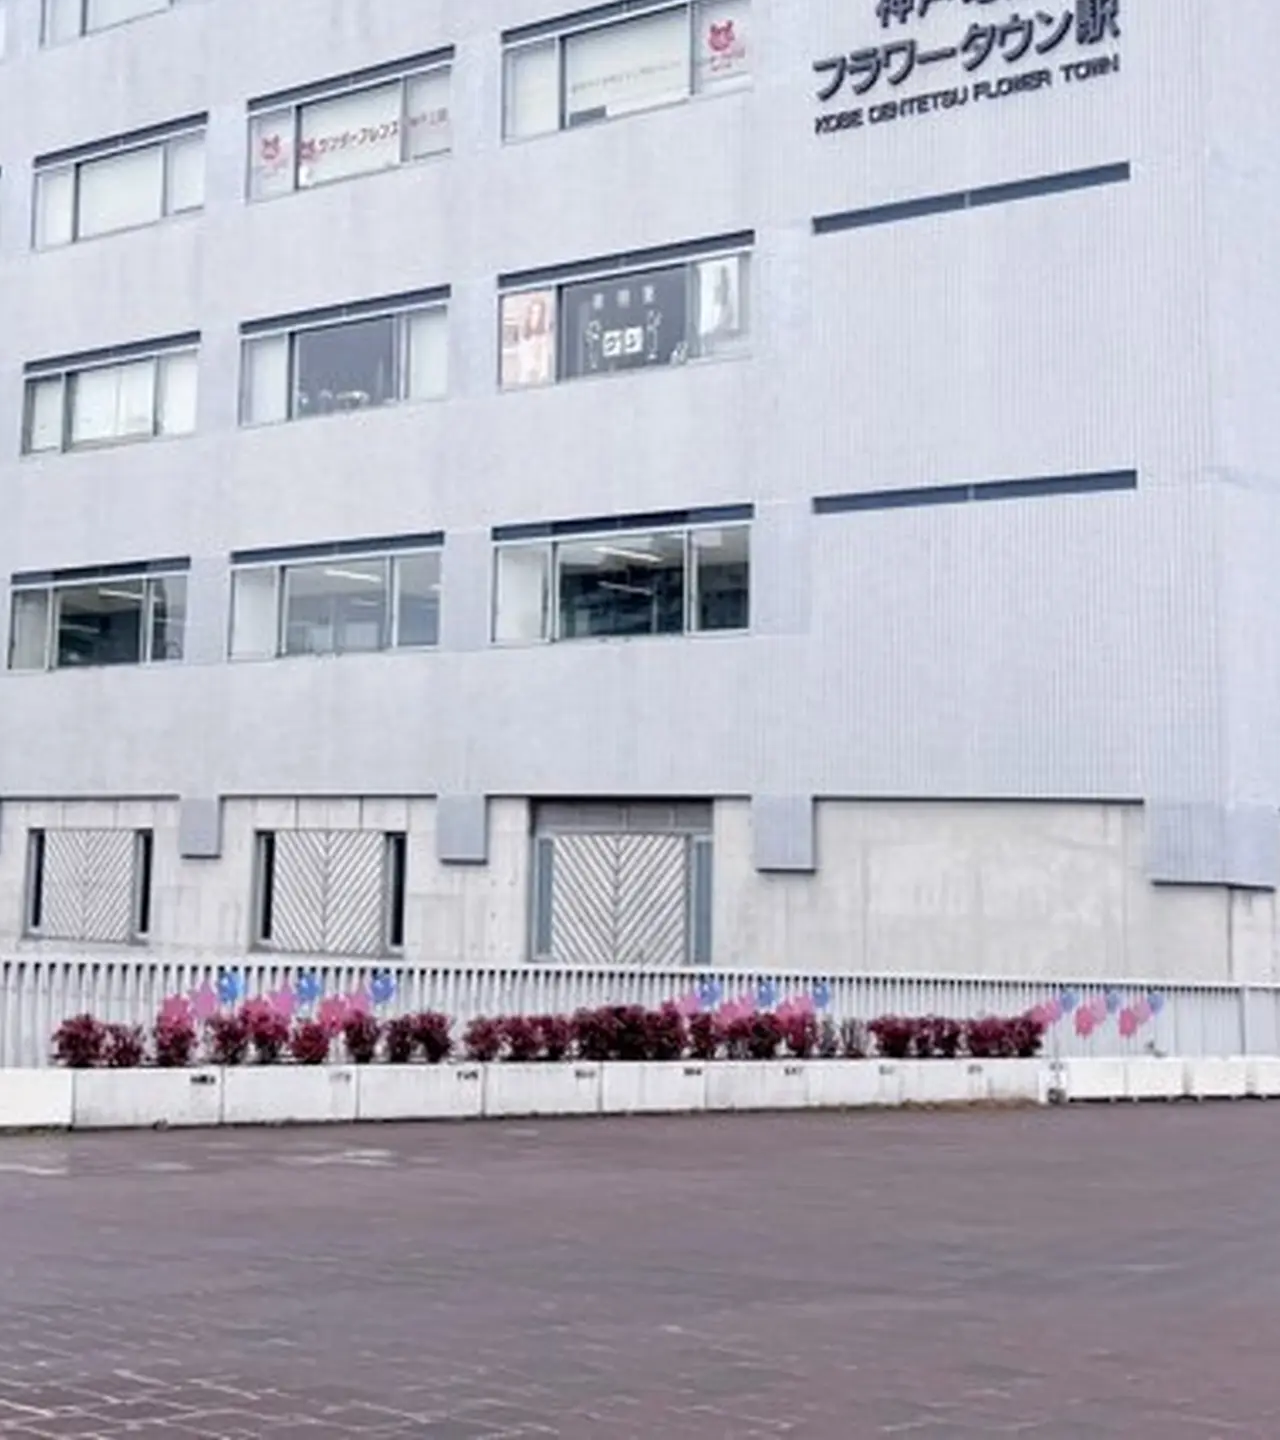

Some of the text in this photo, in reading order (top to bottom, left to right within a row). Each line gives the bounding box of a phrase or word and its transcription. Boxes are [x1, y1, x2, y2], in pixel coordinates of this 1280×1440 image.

[814, 107, 864, 134] KOBE
[972, 68, 1052, 102] FLOWER
[1059, 53, 1120, 84] TOWN
